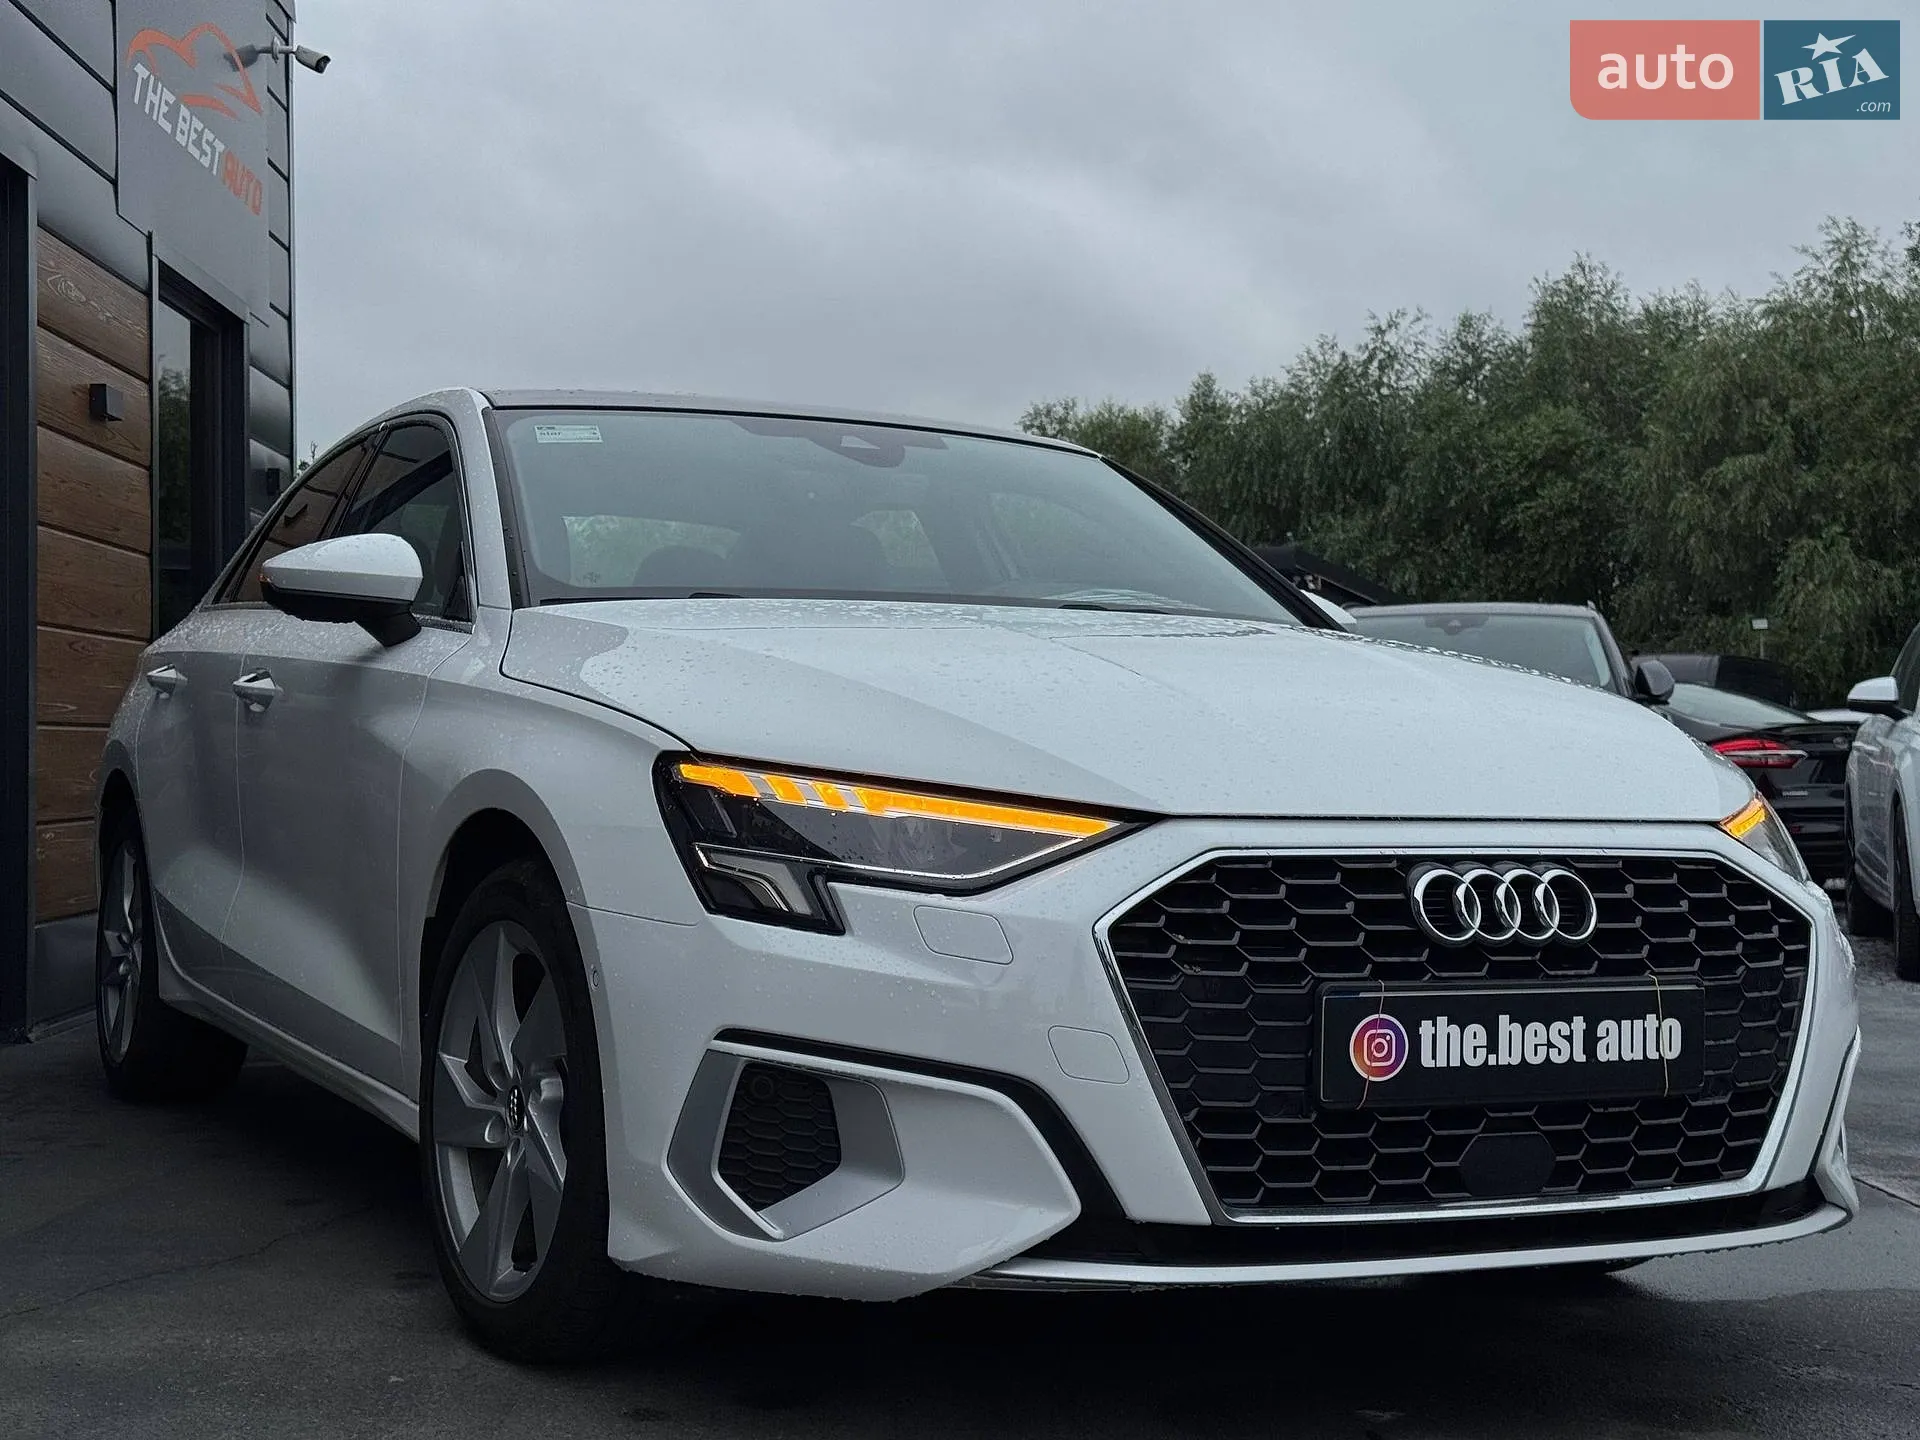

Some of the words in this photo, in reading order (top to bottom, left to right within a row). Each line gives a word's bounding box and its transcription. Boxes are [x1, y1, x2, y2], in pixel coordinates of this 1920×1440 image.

[133, 62, 177, 135] THE
[175, 104, 225, 176] BEST
[221, 150, 263, 216] AUTO
[1418, 1014, 1587, 1068] the.best
[1596, 1013, 1682, 1063] auto
